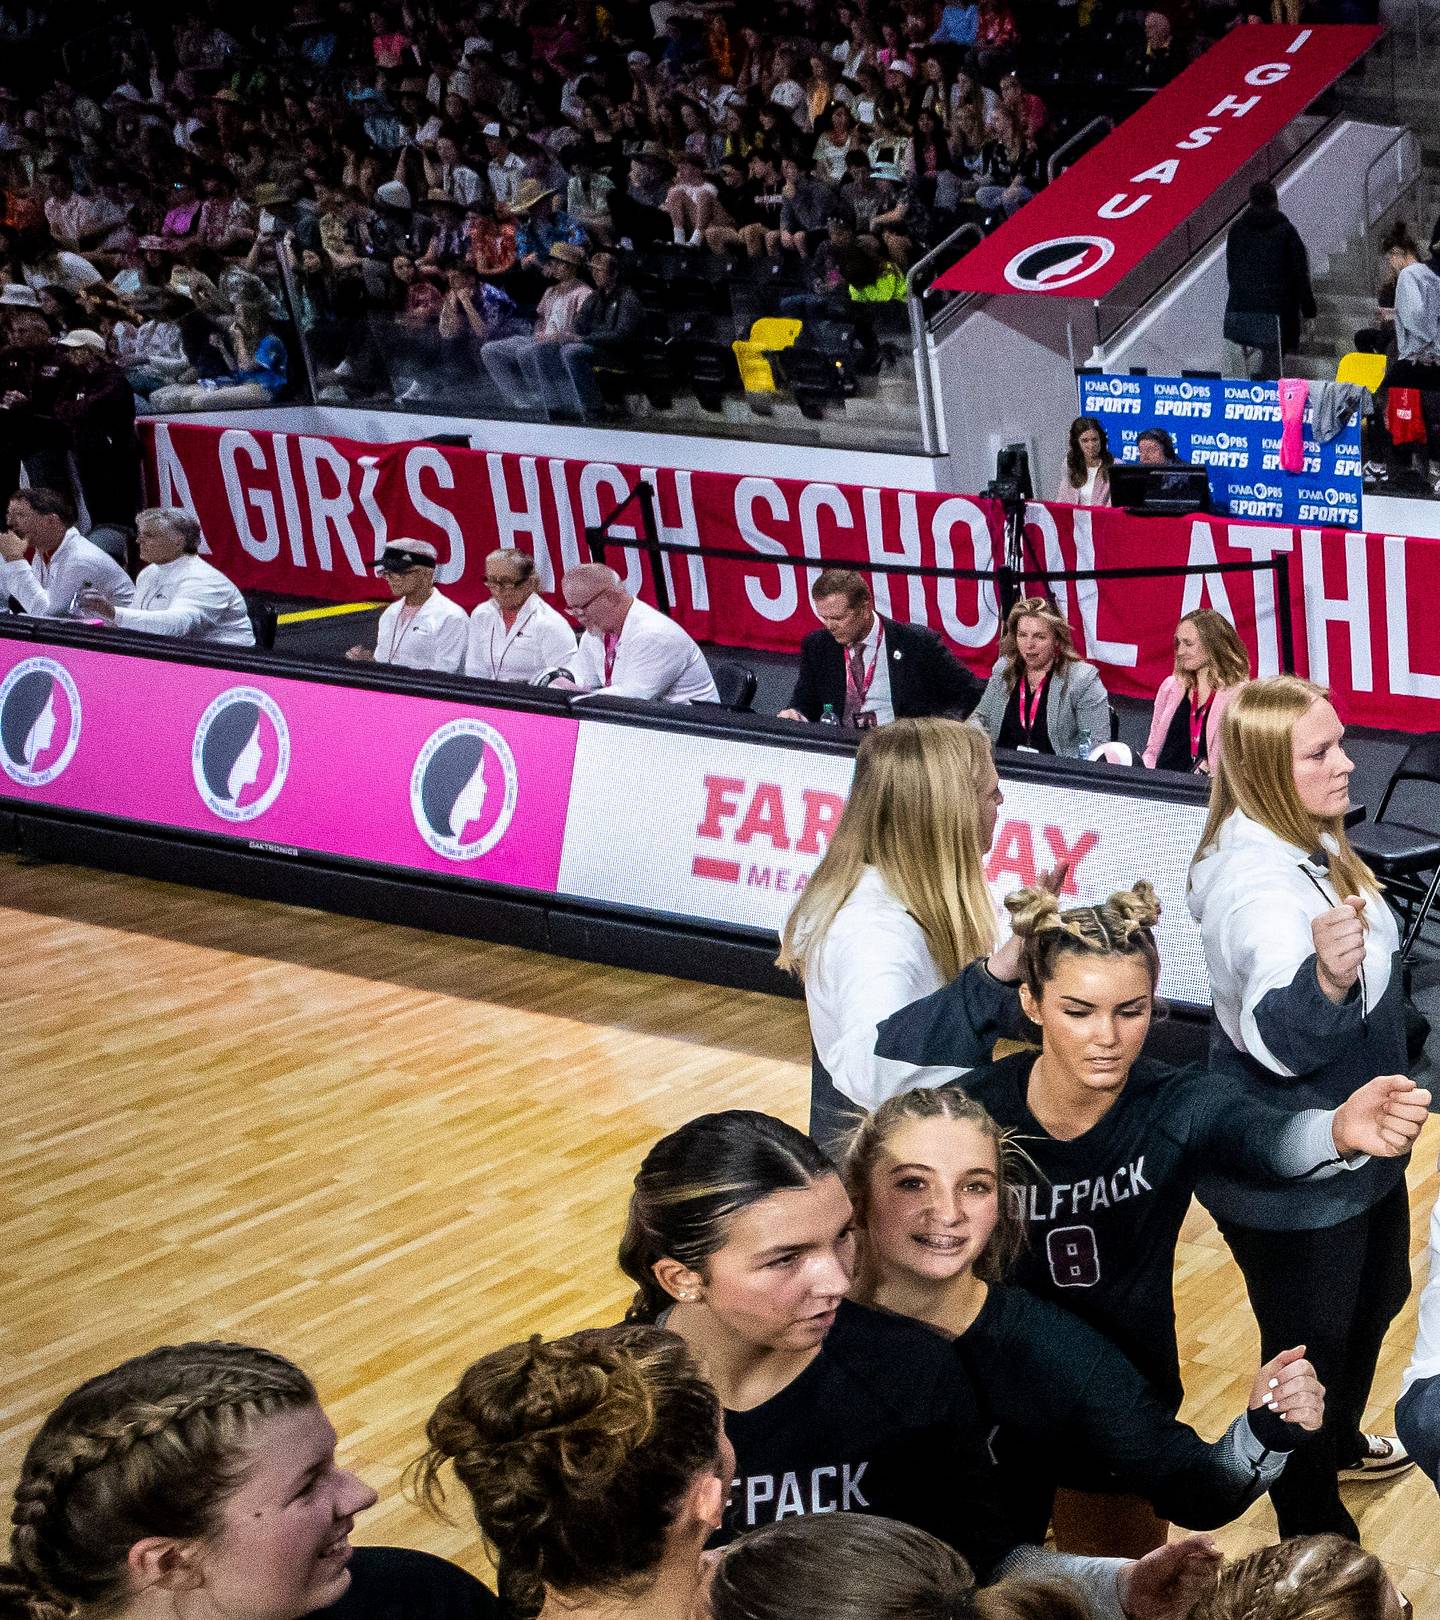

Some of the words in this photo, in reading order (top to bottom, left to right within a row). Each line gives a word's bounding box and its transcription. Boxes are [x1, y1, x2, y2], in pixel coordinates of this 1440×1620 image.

[1098, 29, 1312, 219] IGHSAU
[1085, 379, 1110, 392] IOWA
[1122, 383, 1141, 394] PBS
[1153, 384, 1178, 396] IOWA
[1193, 387, 1211, 398] PBS
[1224, 387, 1250, 400] IOWA
[1085, 396, 1142, 415] SPORTS
[1154, 400, 1212, 418] SPORTS
[1224, 404, 1282, 422] SPORTS
[1191, 434, 1215, 446] IOWA
[1229, 437, 1249, 449] PBS
[1190, 451, 1249, 469] SPORTS
[1261, 454, 1321, 473] SPTS
[1334, 459, 1361, 477] SPO
[1228, 484, 1253, 496] IOWA
[1266, 487, 1283, 498] PBS
[1298, 489, 1324, 501] IOWA
[1339, 492, 1358, 505] PBS
[1229, 500, 1283, 518] SPORTS
[1298, 505, 1359, 524] SPORTS
[218, 429, 466, 585] GIRLS
[486, 453, 710, 611] HIGH
[697, 773, 1100, 895] FARAY
[1008, 1155, 1153, 1221] OLFPACK
[1046, 1225, 1100, 1287] 8
